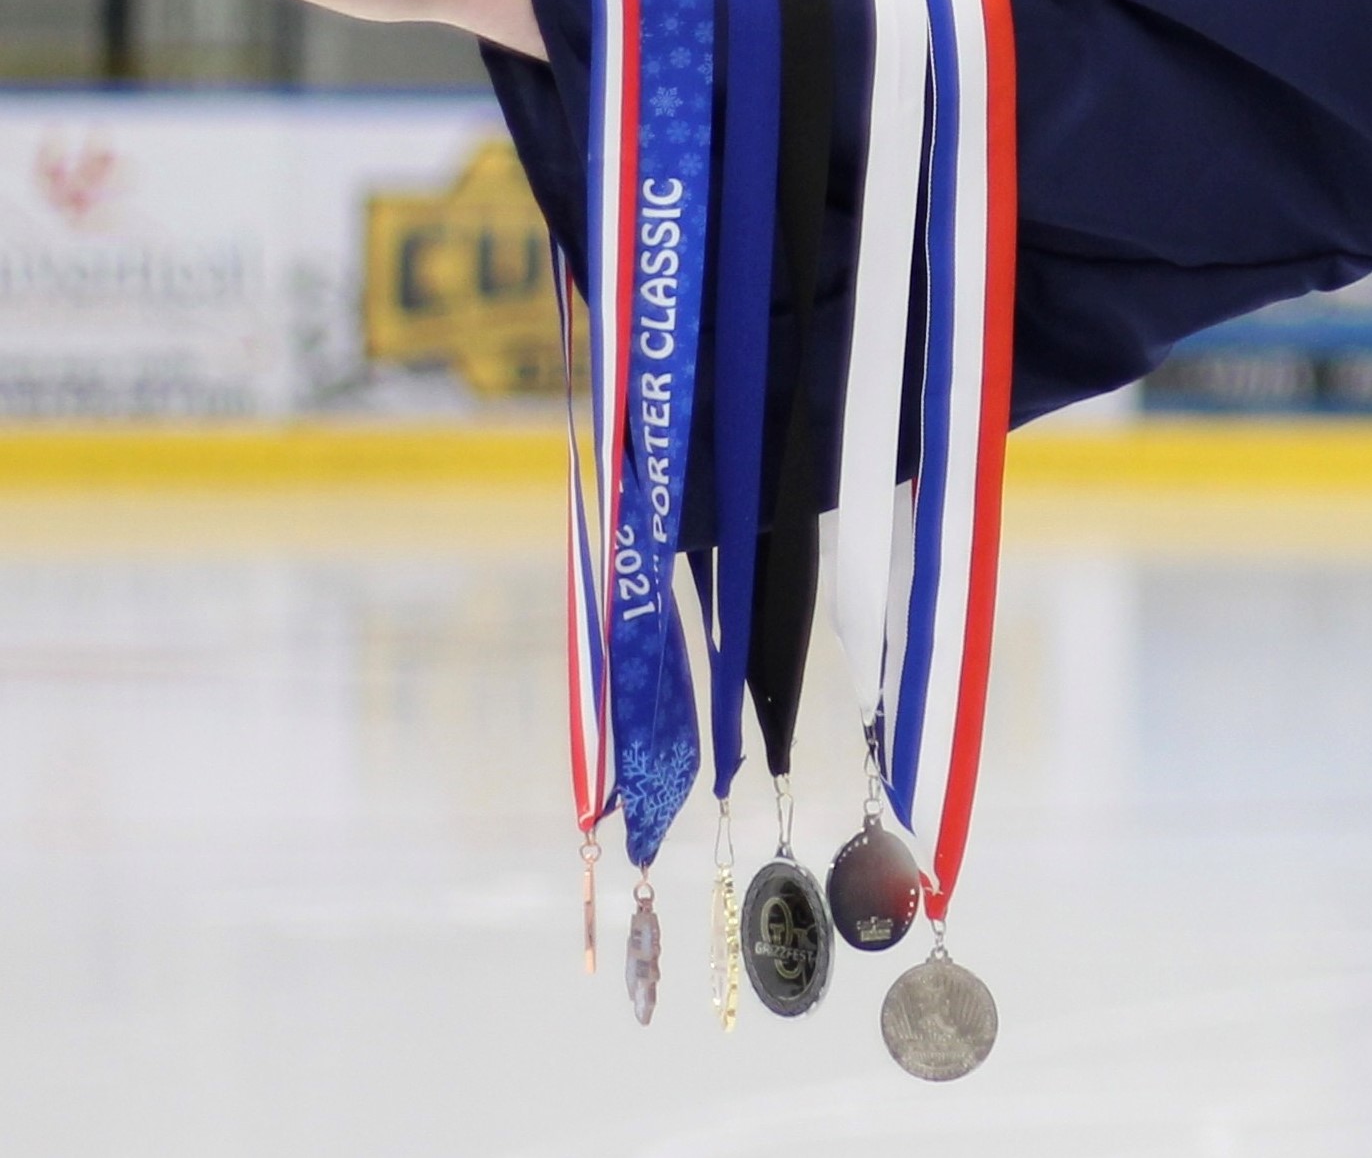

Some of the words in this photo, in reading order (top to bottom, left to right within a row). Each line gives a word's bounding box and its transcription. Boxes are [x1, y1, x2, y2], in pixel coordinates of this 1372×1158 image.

[640, 177, 683, 360] CLASSIC
[641, 372, 673, 543] PORTER
[614, 524, 656, 621] 2021
[754, 941, 815, 961] GRIZZFEST
